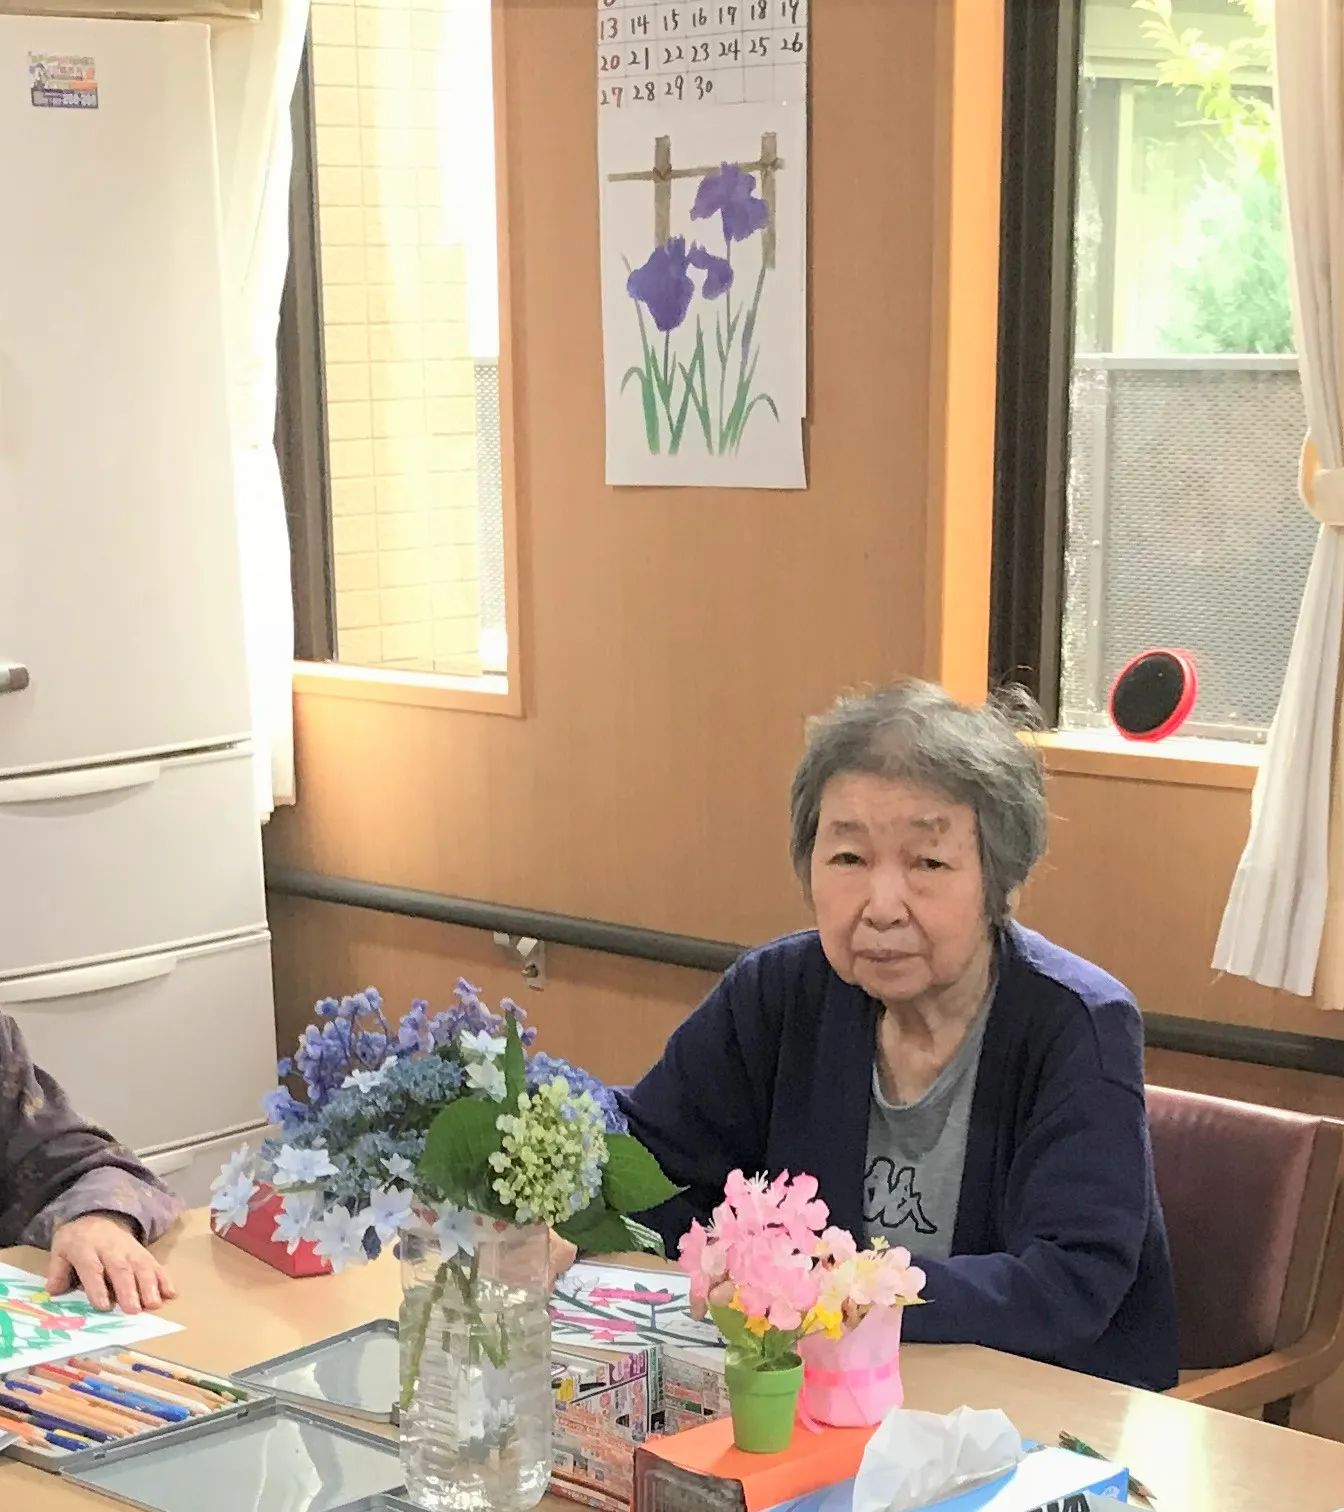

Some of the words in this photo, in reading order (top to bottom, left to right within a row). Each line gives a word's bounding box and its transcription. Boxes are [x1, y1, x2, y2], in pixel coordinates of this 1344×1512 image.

[600, 17, 618, 40] 13
[631, 14, 650, 35] 14
[663, 10, 679, 31] 15
[692, 8, 707, 27] 16
[718, 6, 737, 25] 17
[750, 0, 767, 20] 18
[600, 55, 620, 71] 20
[627, 47, 650, 70] 21
[662, 46, 684, 64] 22
[691, 43, 710, 62] 23
[718, 39, 740, 61] 24
[749, 36, 770, 56] 25
[780, 32, 803, 52] 26
[600, 87, 623, 108] 27
[633, 81, 655, 101] 28
[664, 75, 684, 100] 29
[694, 75, 713, 100] 30
